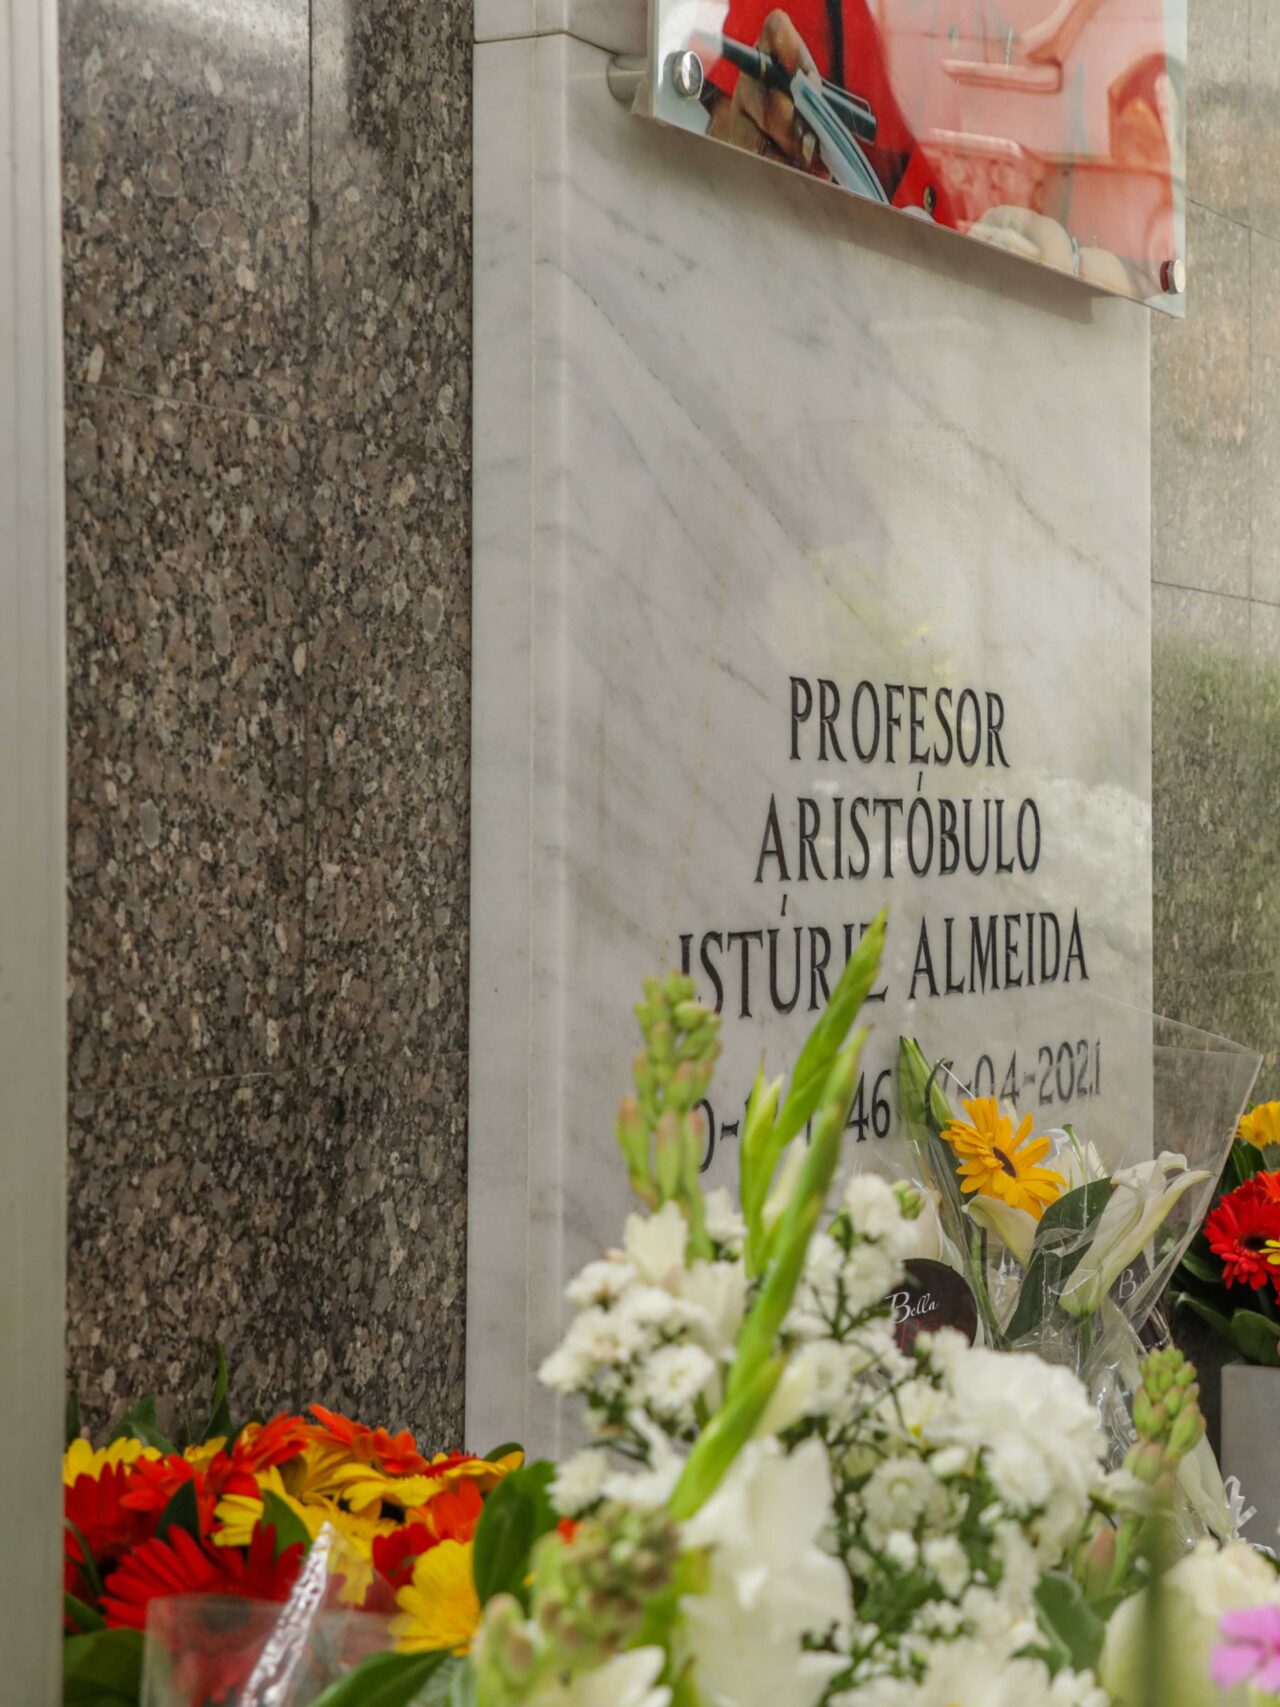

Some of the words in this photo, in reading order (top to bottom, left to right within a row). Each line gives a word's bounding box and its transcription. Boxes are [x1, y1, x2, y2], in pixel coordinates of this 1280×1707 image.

[789, 675, 1011, 768] PROFESOR
[754, 771, 1042, 883] ARISTÓBULO
[907, 907, 1090, 1000] ALMEIDA
[885, 1291, 939, 1325] Bella
